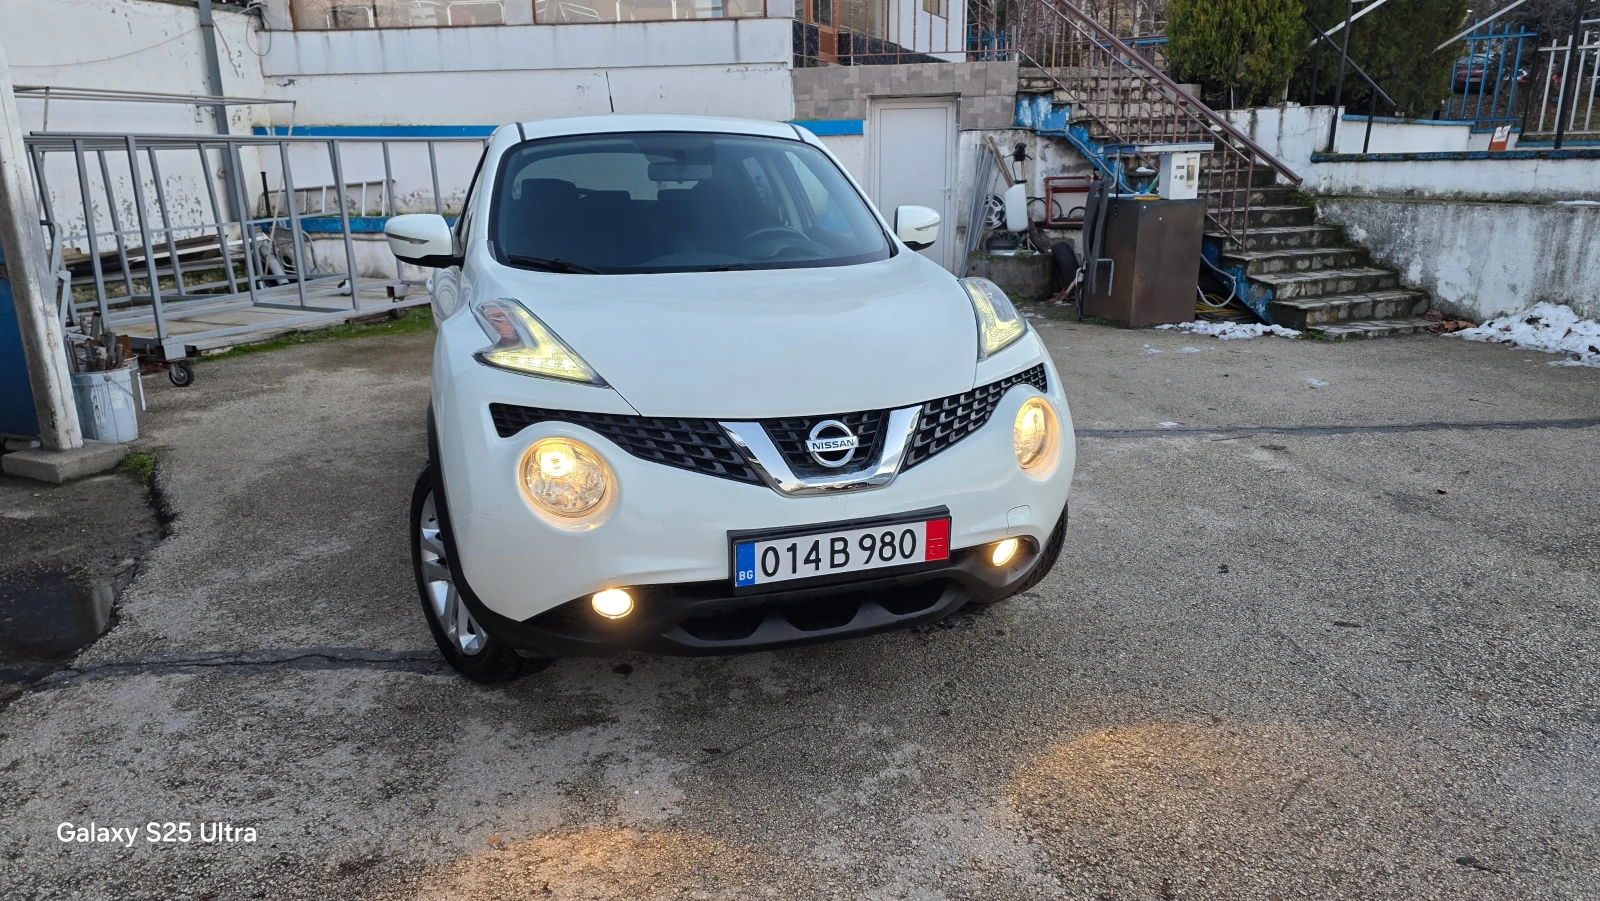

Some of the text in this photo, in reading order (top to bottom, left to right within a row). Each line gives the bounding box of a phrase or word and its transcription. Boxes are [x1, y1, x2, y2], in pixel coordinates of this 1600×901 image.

[812, 439, 855, 450] NISSAN
[858, 528, 917, 565] 980
[929, 544, 943, 556] 27
[739, 570, 754, 581] BG
